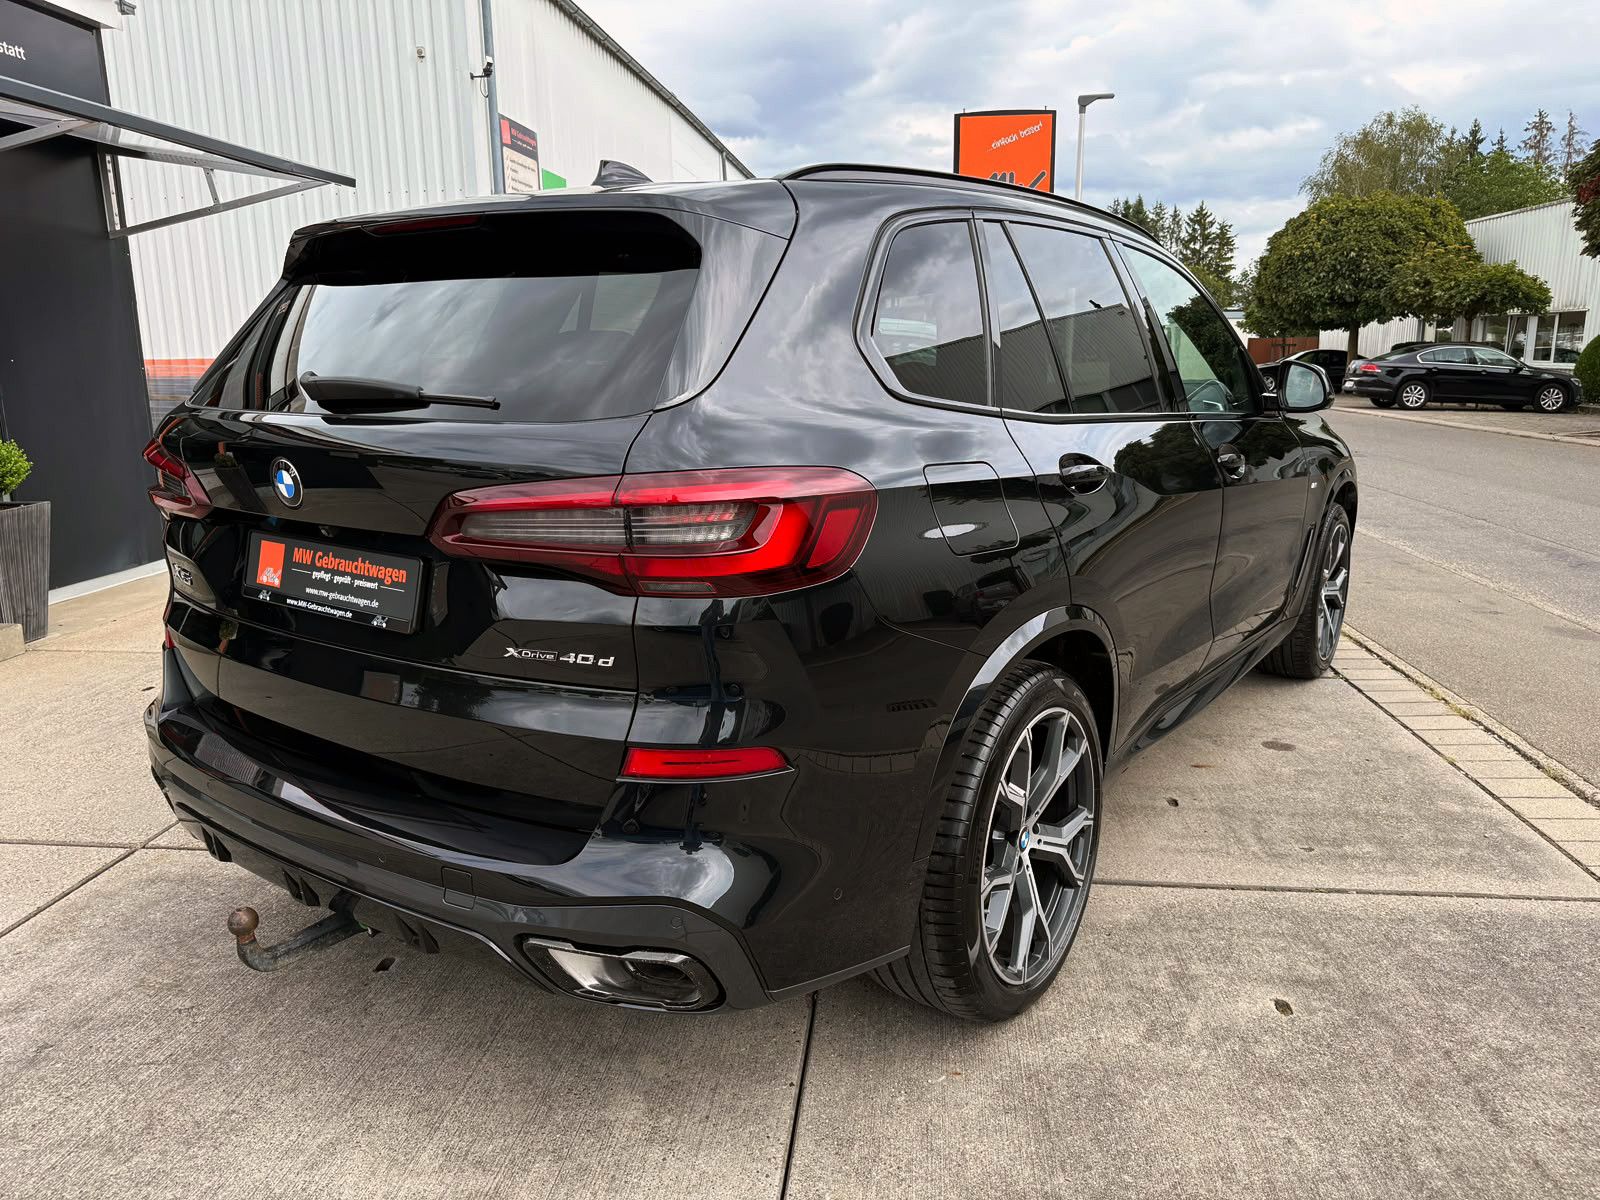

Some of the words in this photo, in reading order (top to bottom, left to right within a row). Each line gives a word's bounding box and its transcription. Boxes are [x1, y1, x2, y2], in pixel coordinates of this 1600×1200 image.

[292, 547, 313, 565] MW
[315, 551, 407, 585] Gebrauchtwagen
[312, 570, 332, 582] gepflegt
[353, 578, 379, 590] preiswert
[305, 586, 379, 608] www.mw-gebrauchtwagen.de
[286, 598, 353, 618] www.MW-Gebrauchtwagen.de
